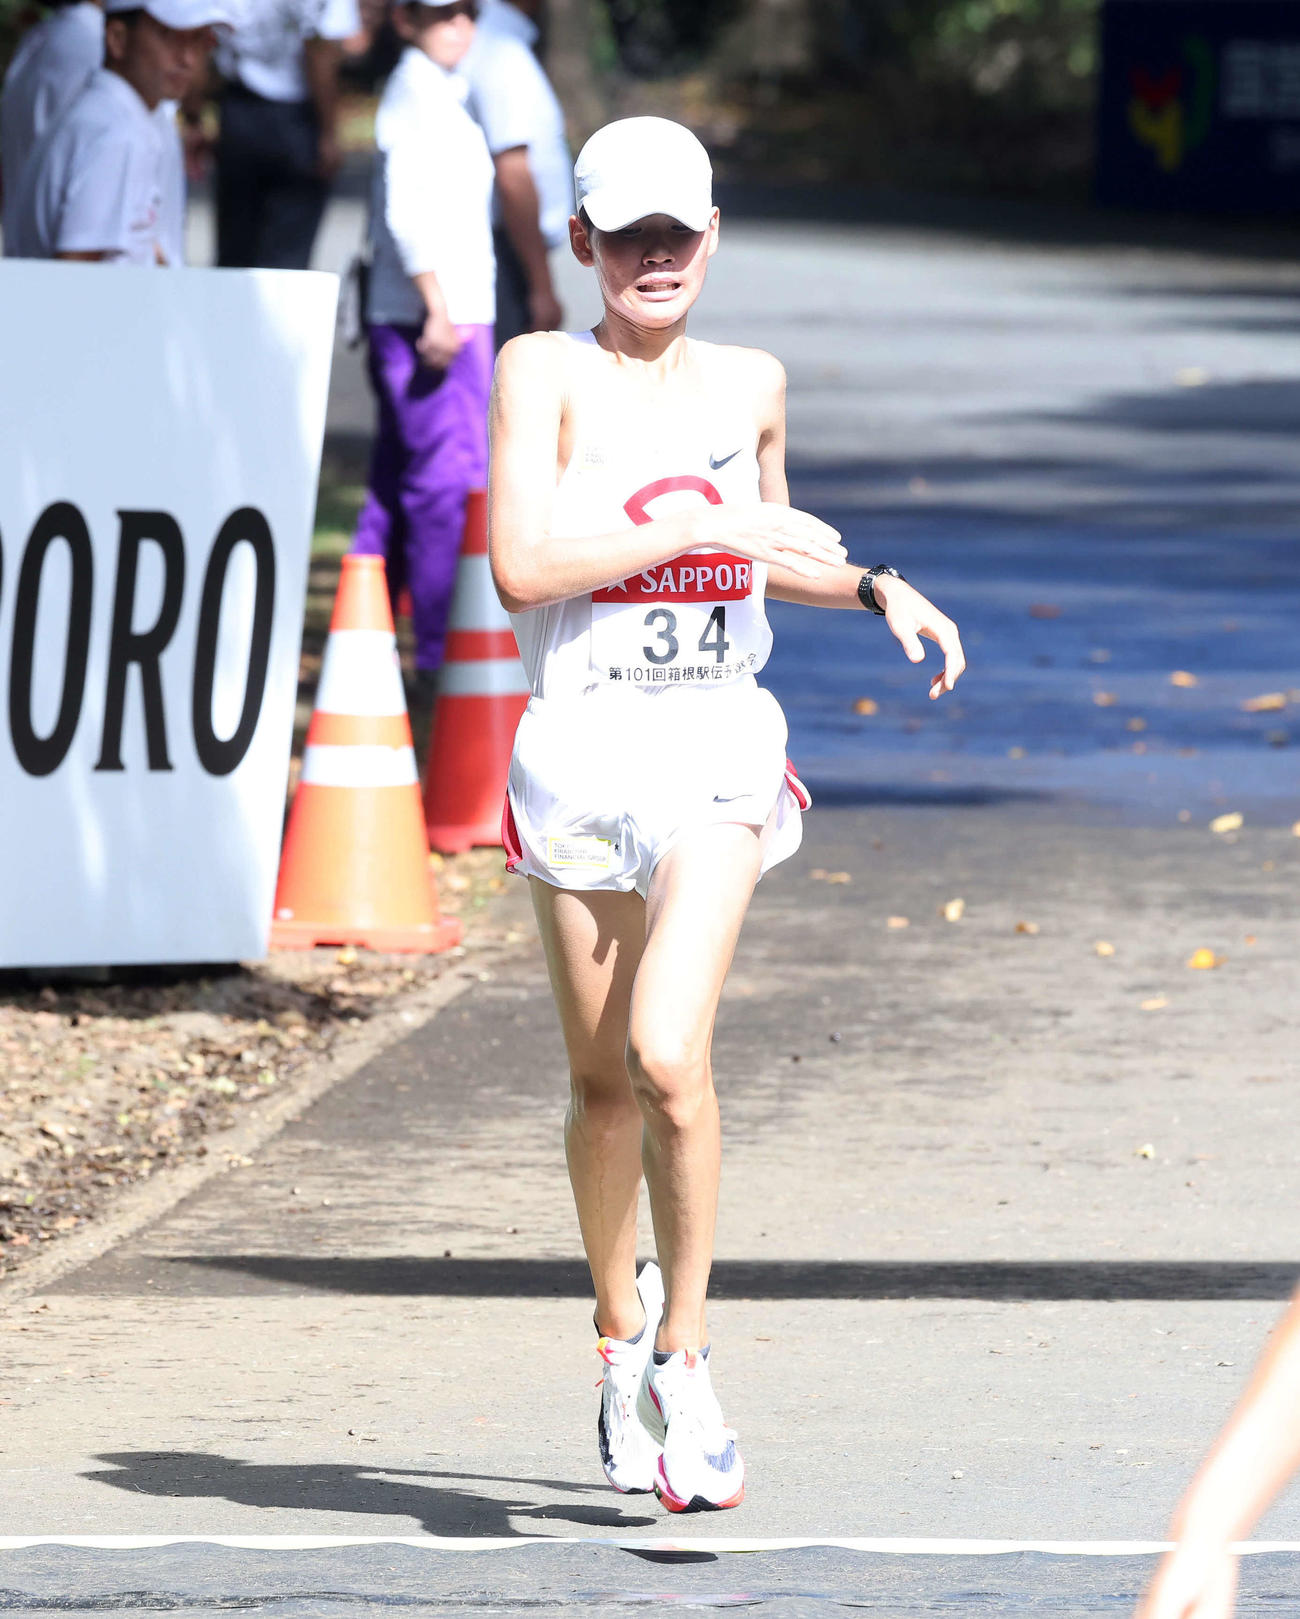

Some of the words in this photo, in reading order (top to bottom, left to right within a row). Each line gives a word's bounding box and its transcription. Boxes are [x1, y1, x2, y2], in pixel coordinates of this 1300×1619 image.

[640, 563, 750, 594] SAPPOR
[0, 501, 276, 778] ORO
[642, 605, 730, 665] 34
